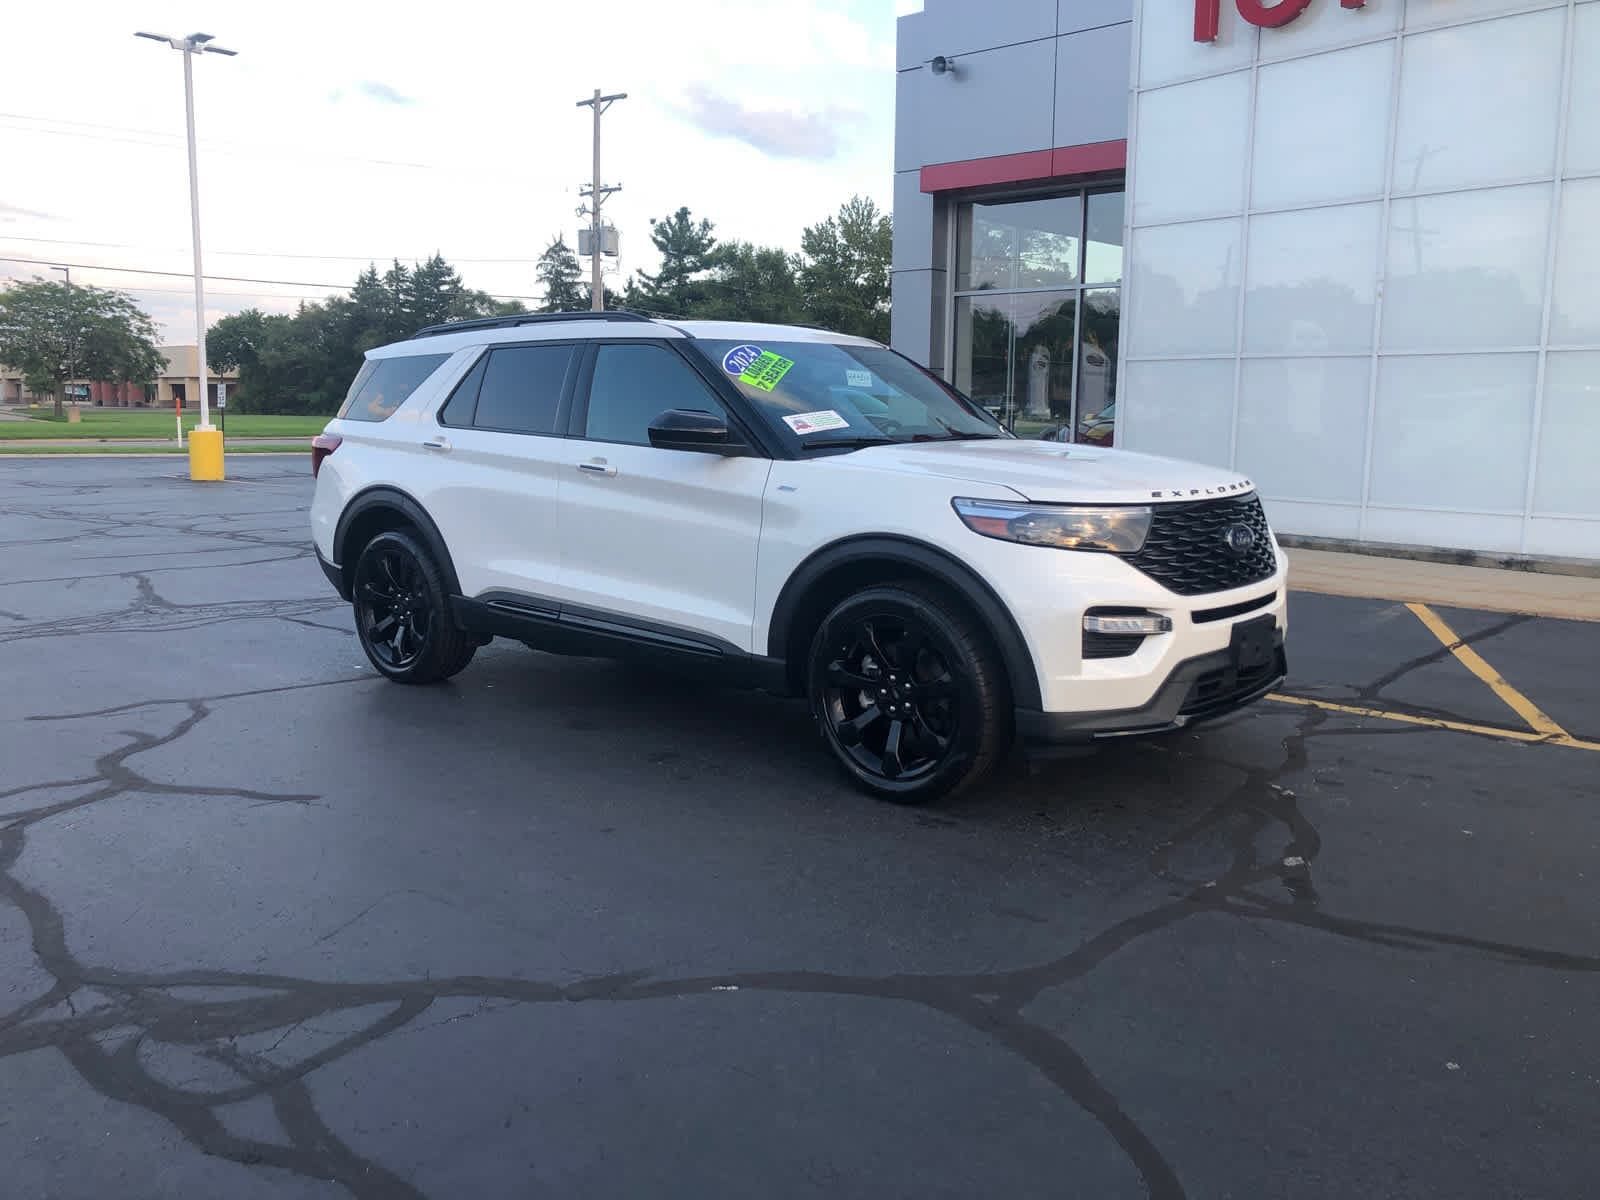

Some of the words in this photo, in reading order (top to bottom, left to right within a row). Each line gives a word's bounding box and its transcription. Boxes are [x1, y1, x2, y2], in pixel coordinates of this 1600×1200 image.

[728, 346, 758, 372] 2024
[744, 355, 776, 379] LOADED
[761, 358, 792, 383] SEATER
[756, 381, 769, 390] 7
[1151, 479, 1251, 498] EXPLORER
